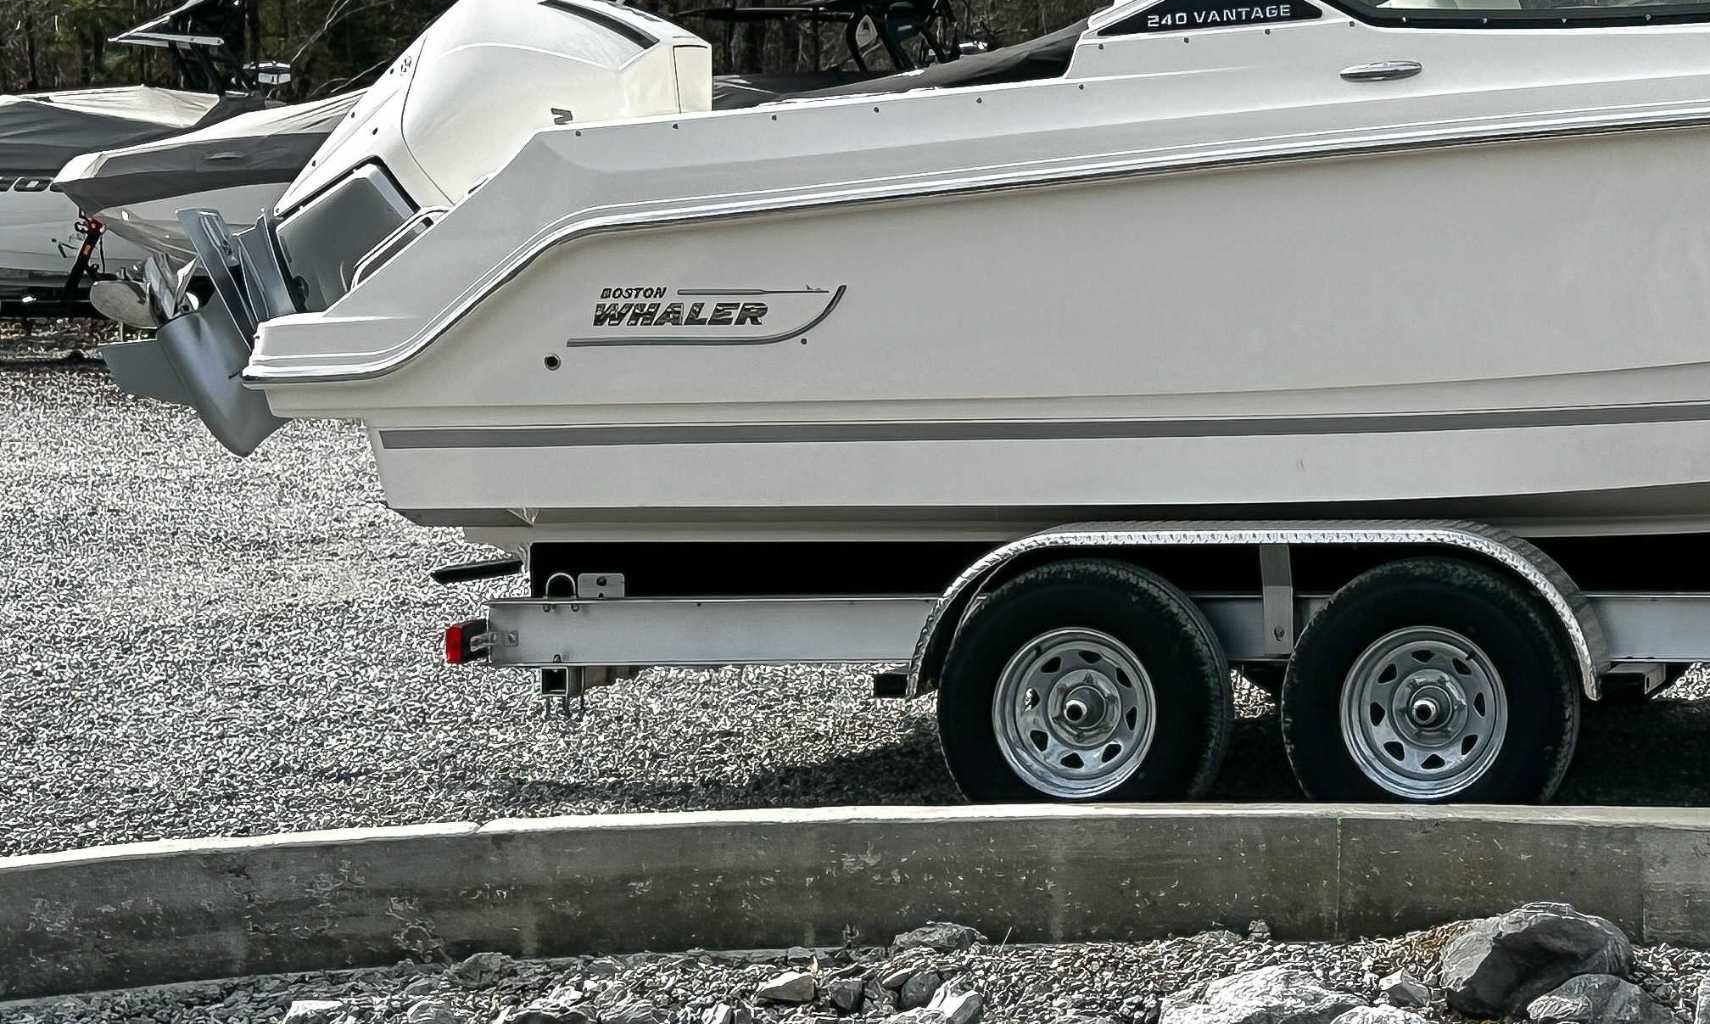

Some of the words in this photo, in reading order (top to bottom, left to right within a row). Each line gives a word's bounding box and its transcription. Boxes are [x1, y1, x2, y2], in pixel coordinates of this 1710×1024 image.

[1147, 12, 1188, 27] 240
[1193, 4, 1291, 23] VANTAGE
[600, 287, 667, 299] BOSTON
[593, 302, 769, 327] WHALER
